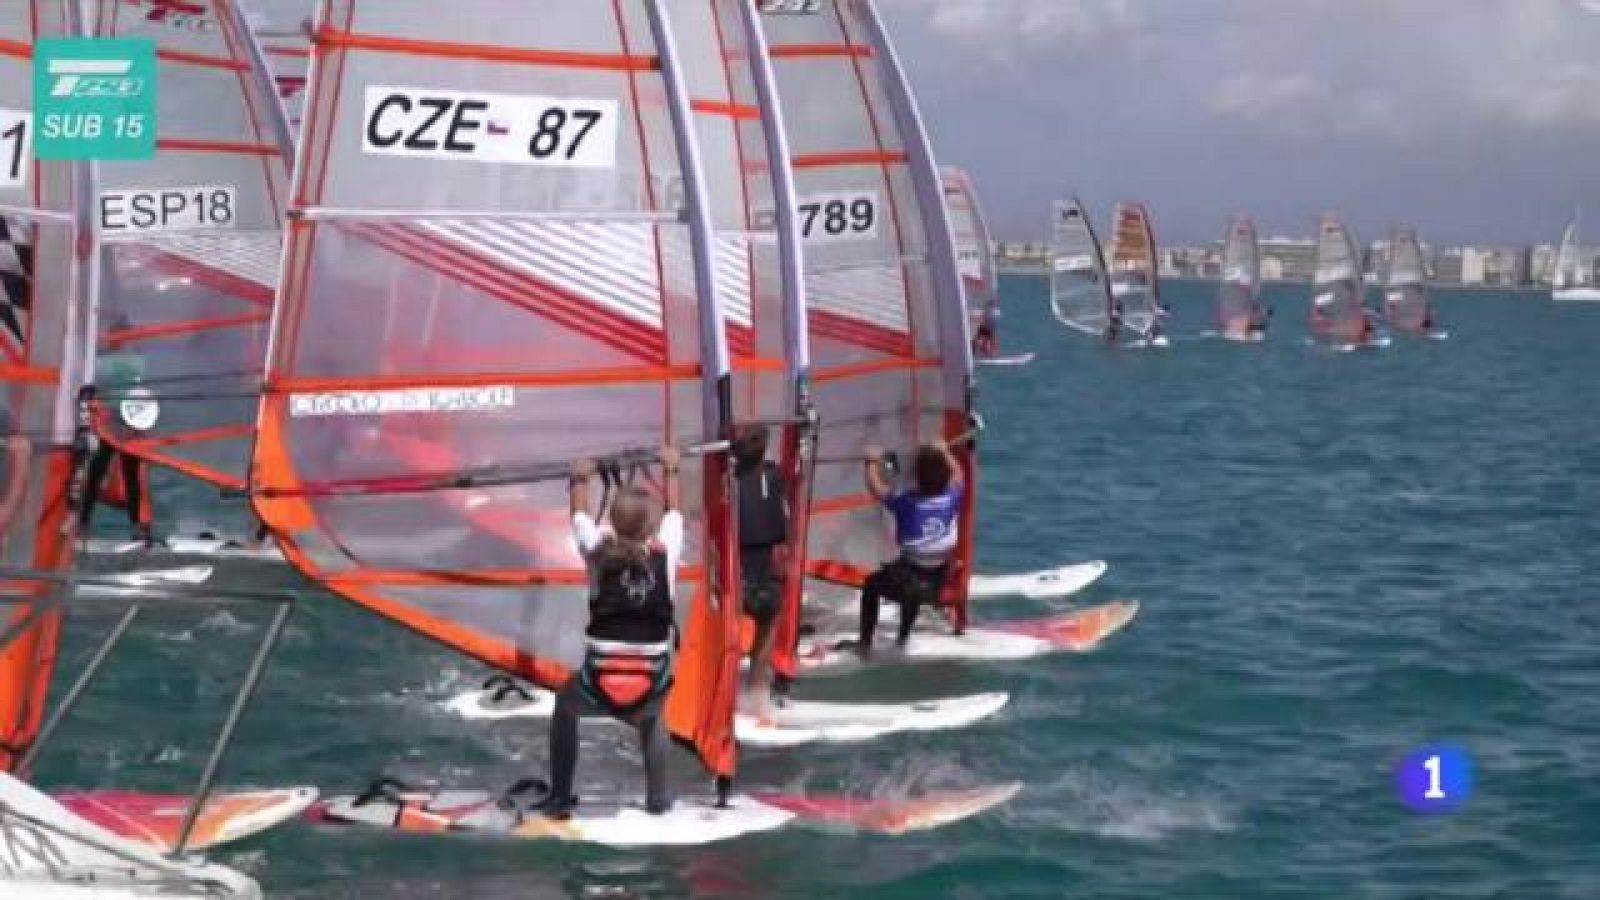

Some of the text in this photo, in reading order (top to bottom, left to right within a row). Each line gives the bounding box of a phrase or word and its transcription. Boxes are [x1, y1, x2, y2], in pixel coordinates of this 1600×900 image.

[528, 106, 603, 160] 87
[101, 189, 232, 229] ESP18
[798, 198, 874, 238] 789
